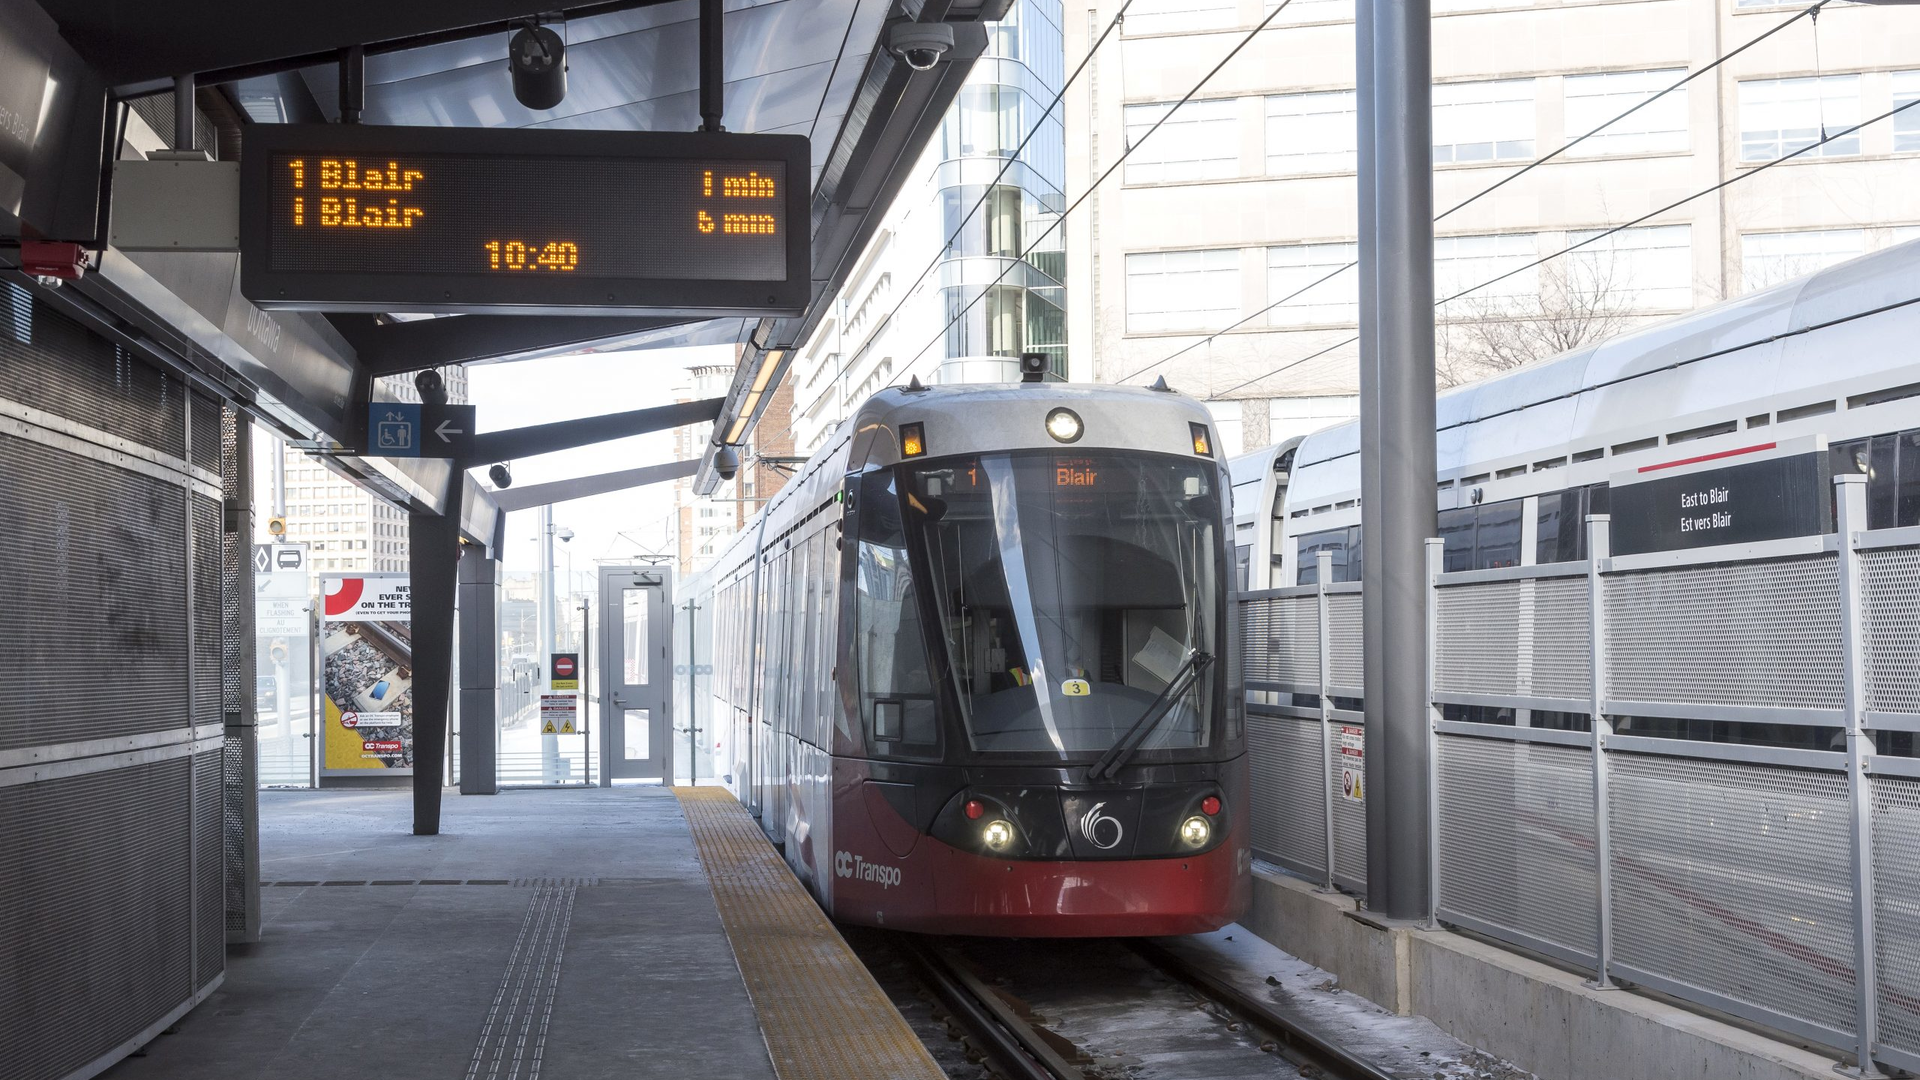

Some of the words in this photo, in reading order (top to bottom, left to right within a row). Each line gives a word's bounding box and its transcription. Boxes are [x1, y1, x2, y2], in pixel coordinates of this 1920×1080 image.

[0, 105, 12, 130] ers
[289, 160, 304, 189] 1
[321, 160, 424, 191] Blair
[723, 171, 775, 198] min
[321, 197, 424, 229] Blair
[485, 241, 578, 272] 10:40
[967, 467, 977, 487] 1
[1056, 467, 1098, 487] Blair
[1681, 492, 1698, 508] East
[1699, 491, 1709, 506] to
[1710, 486, 1729, 504] Blair
[1680, 517, 1694, 532] Est
[1694, 516, 1711, 531] vers
[1712, 510, 1732, 529] Blair
[272, 601, 289, 609] WHEN
[361, 601, 375, 609] ON
[377, 601, 396, 609] THE
[378, 593, 403, 601] EVER
[266, 609, 295, 617] FLASHING
[259, 626, 302, 634] CLIGNOTEMENT
[1072, 683, 1081, 694] 3
[364, 742, 375, 750] OC
[375, 742, 399, 751] Transpo
[834, 849, 853, 879] OC
[854, 854, 902, 890] Transpo
